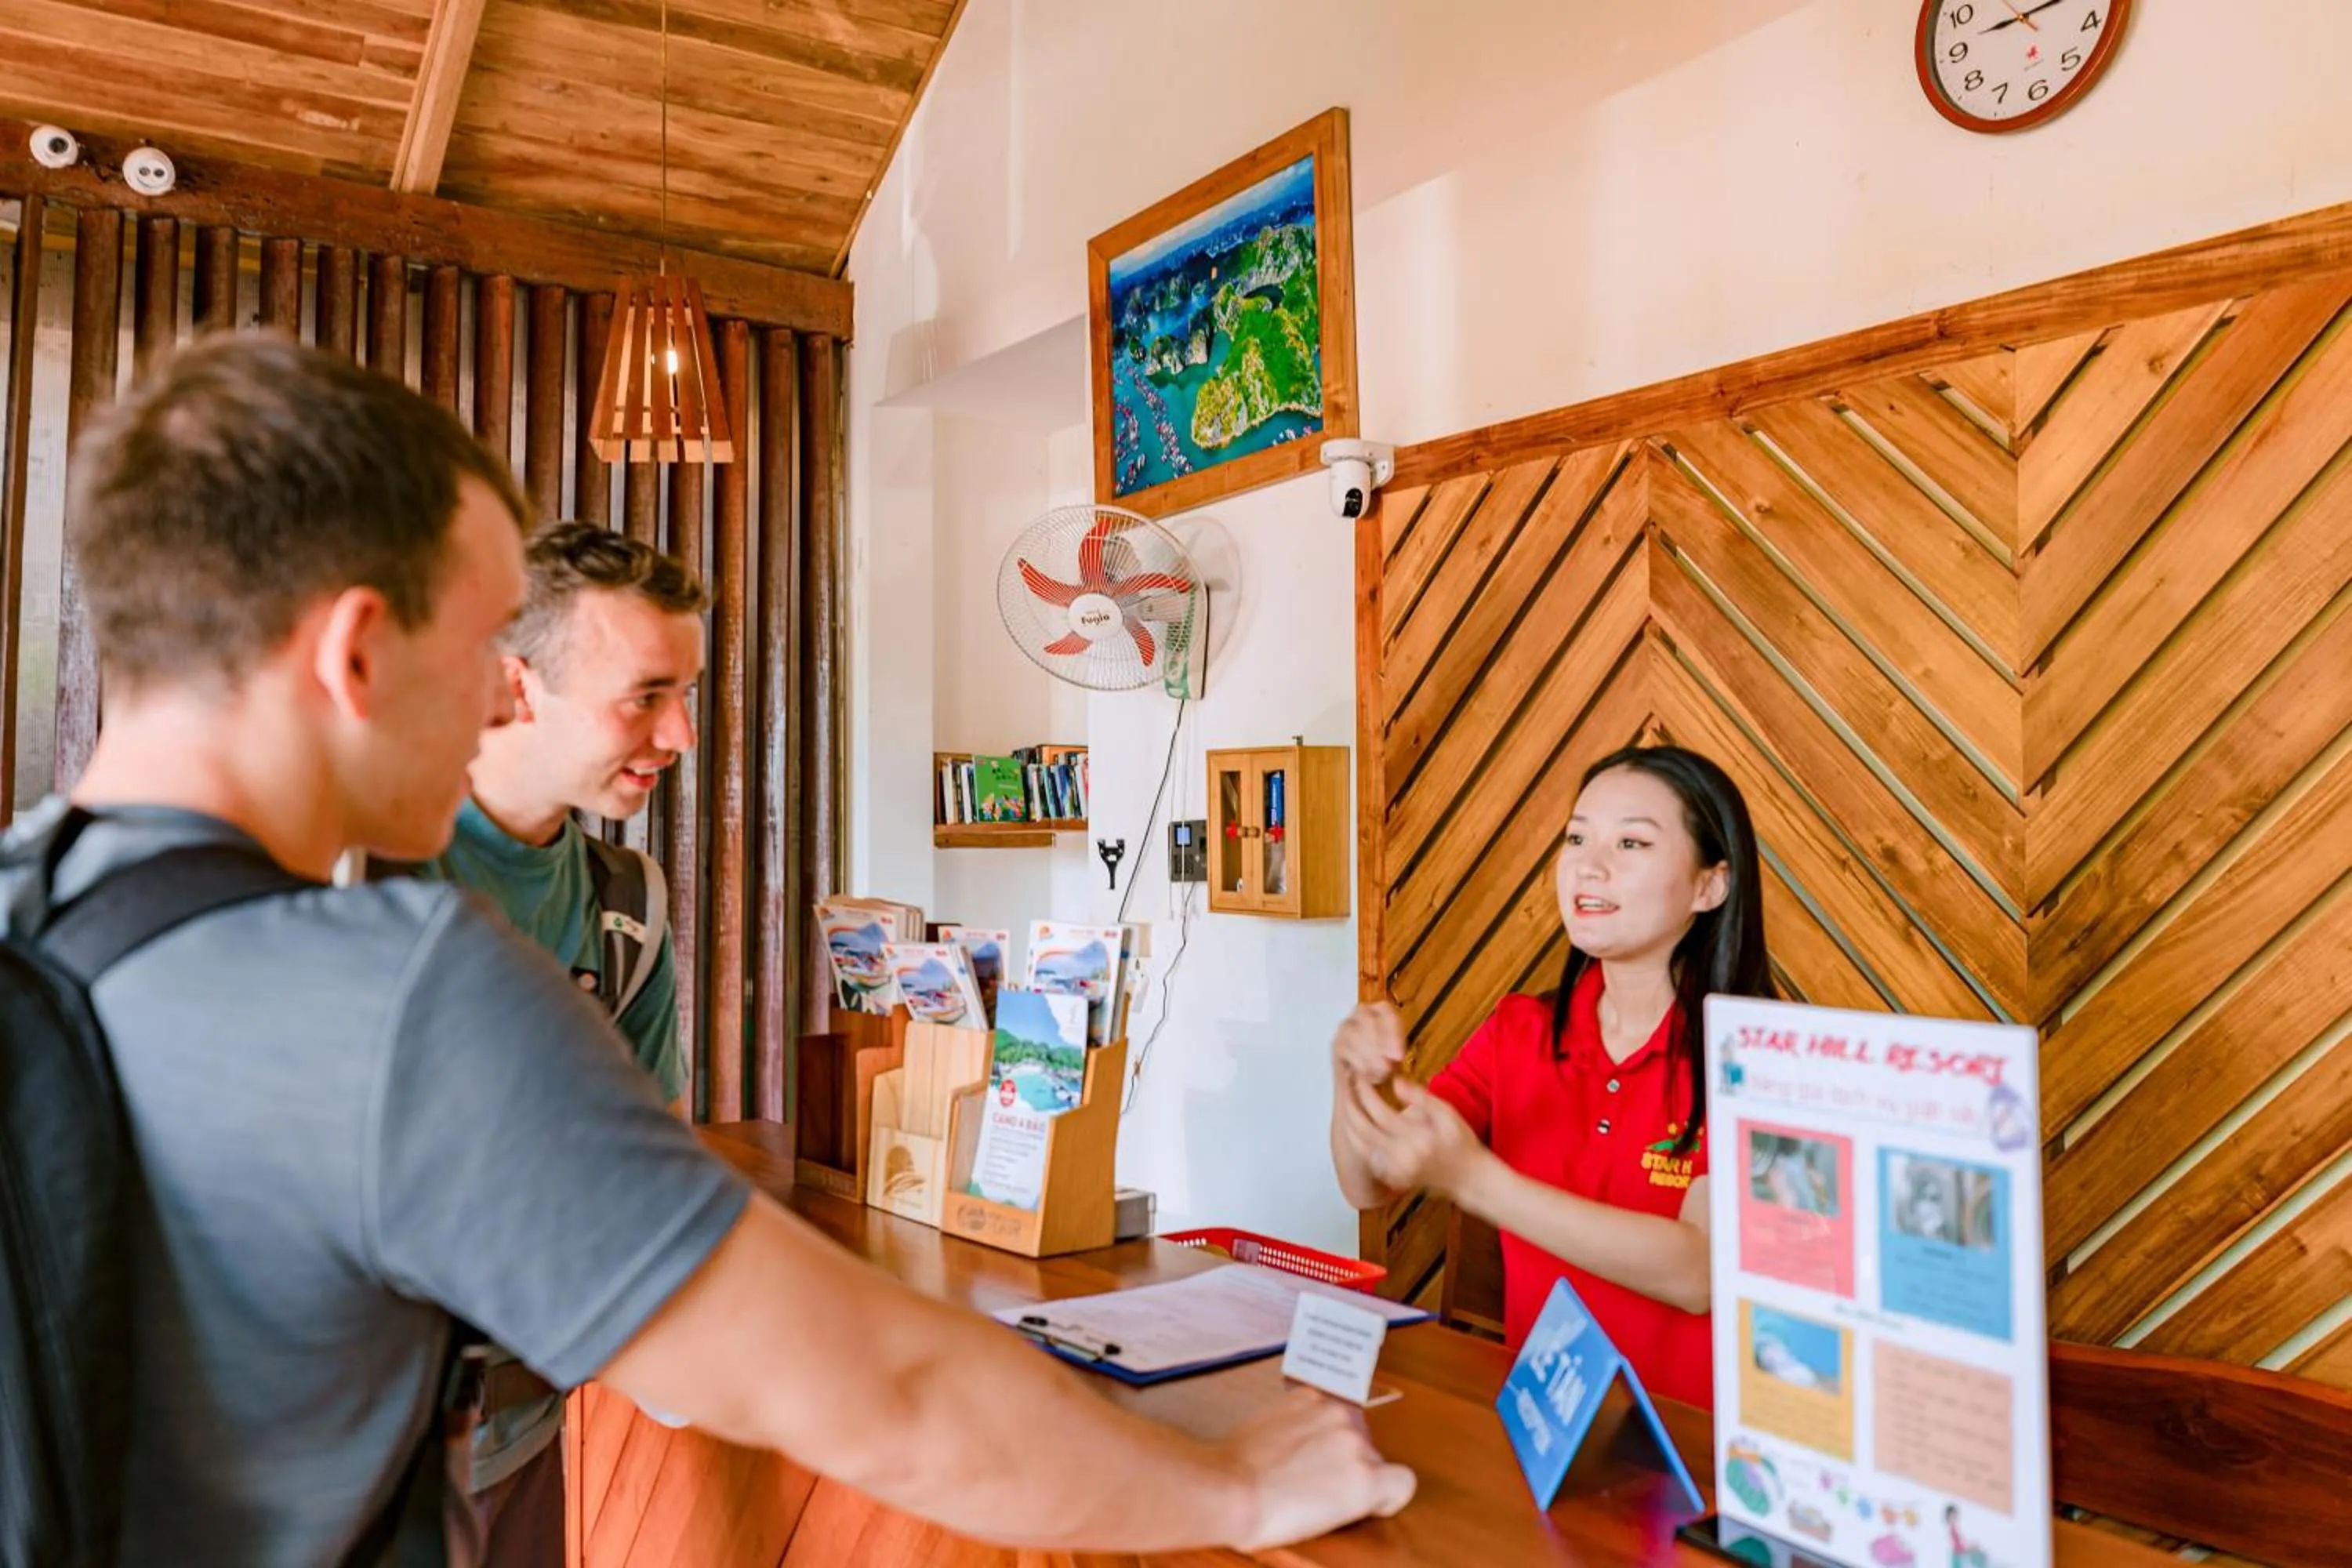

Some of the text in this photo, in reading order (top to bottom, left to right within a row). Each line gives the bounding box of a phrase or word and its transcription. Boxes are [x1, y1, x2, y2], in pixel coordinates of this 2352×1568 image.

[1950, 4, 1974, 29] 10
[2080, 9, 2102, 33] 4
[1949, 42, 1969, 64] 9
[2061, 46, 2082, 71] 5
[1964, 70, 1984, 92] 8
[2027, 79, 2049, 101] 6
[1991, 82, 2009, 104] 7
[1737, 1025, 2009, 1087] STAR HILL RESORT
[1649, 1171, 1691, 1188] RESOR
